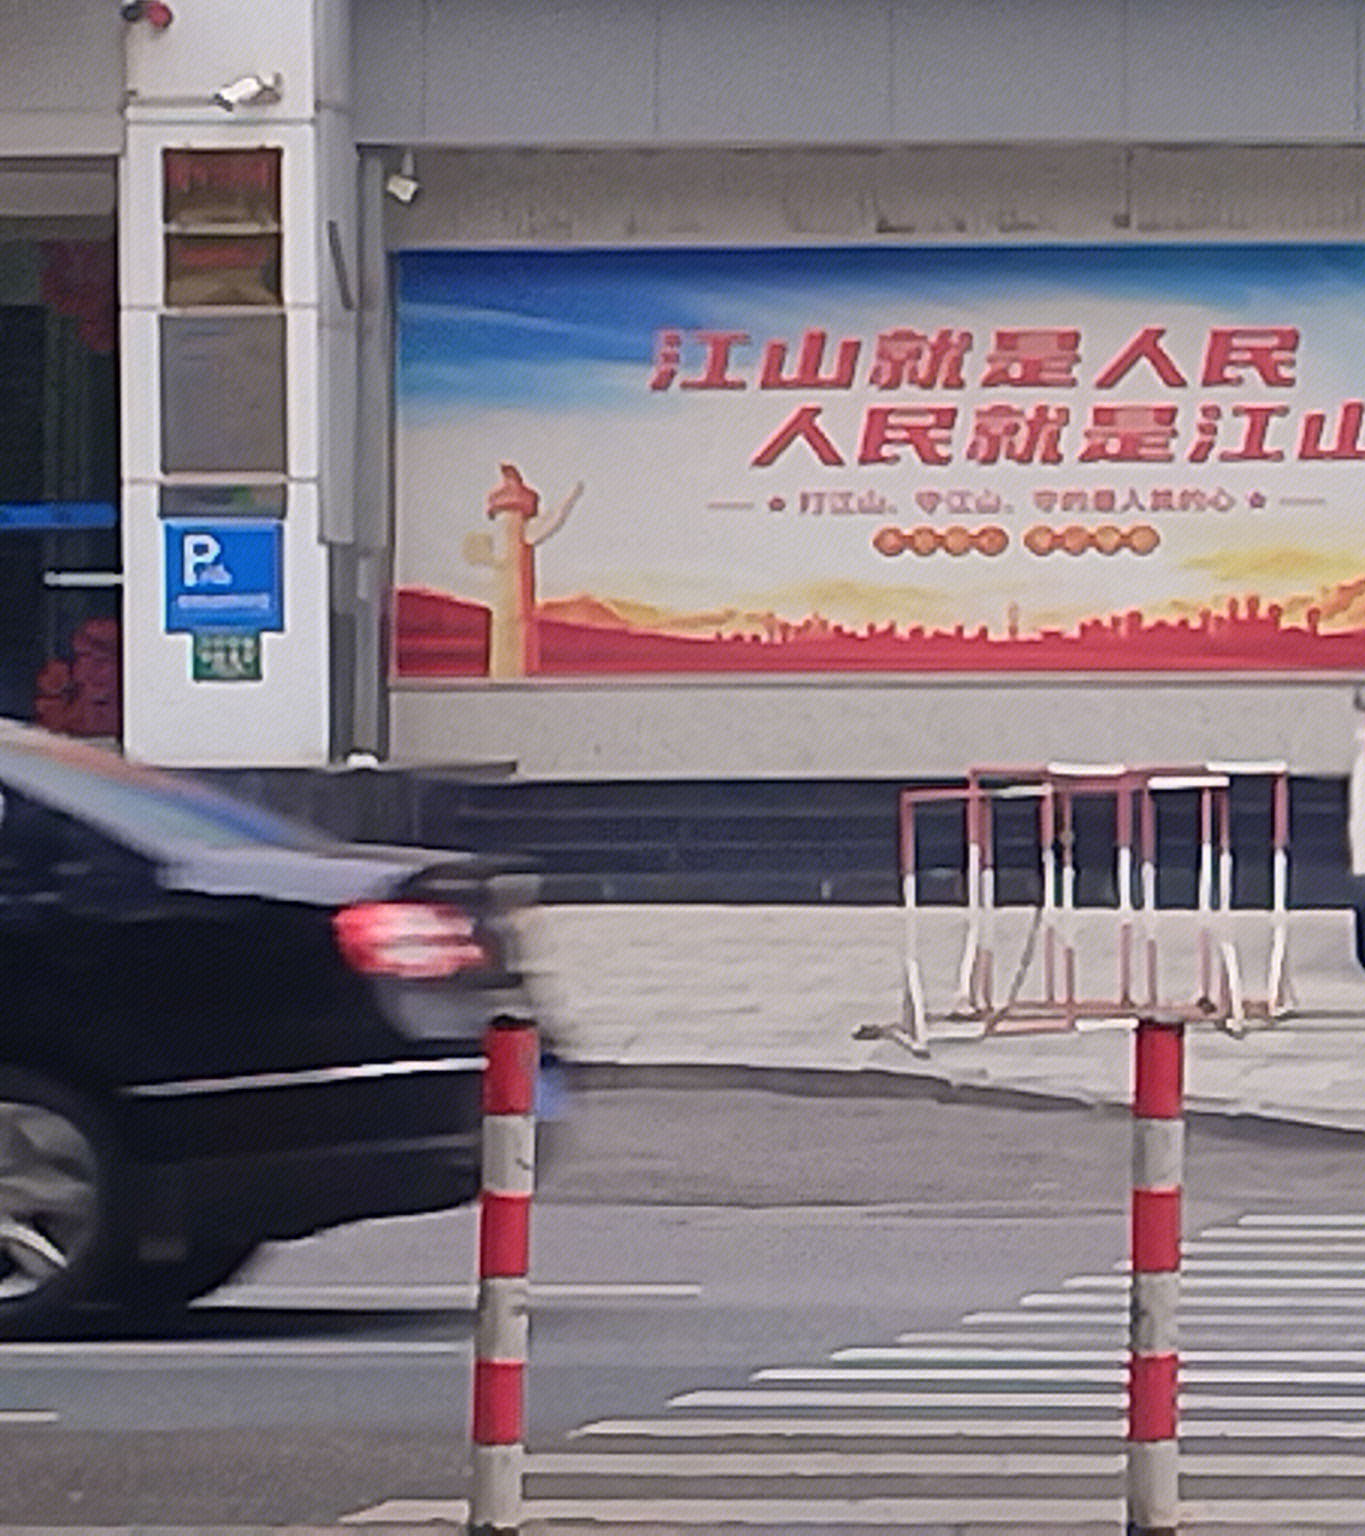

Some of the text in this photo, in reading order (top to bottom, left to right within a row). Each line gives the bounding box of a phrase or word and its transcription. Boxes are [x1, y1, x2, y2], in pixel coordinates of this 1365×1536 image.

[650, 326, 1299, 390] 江山就是人民
